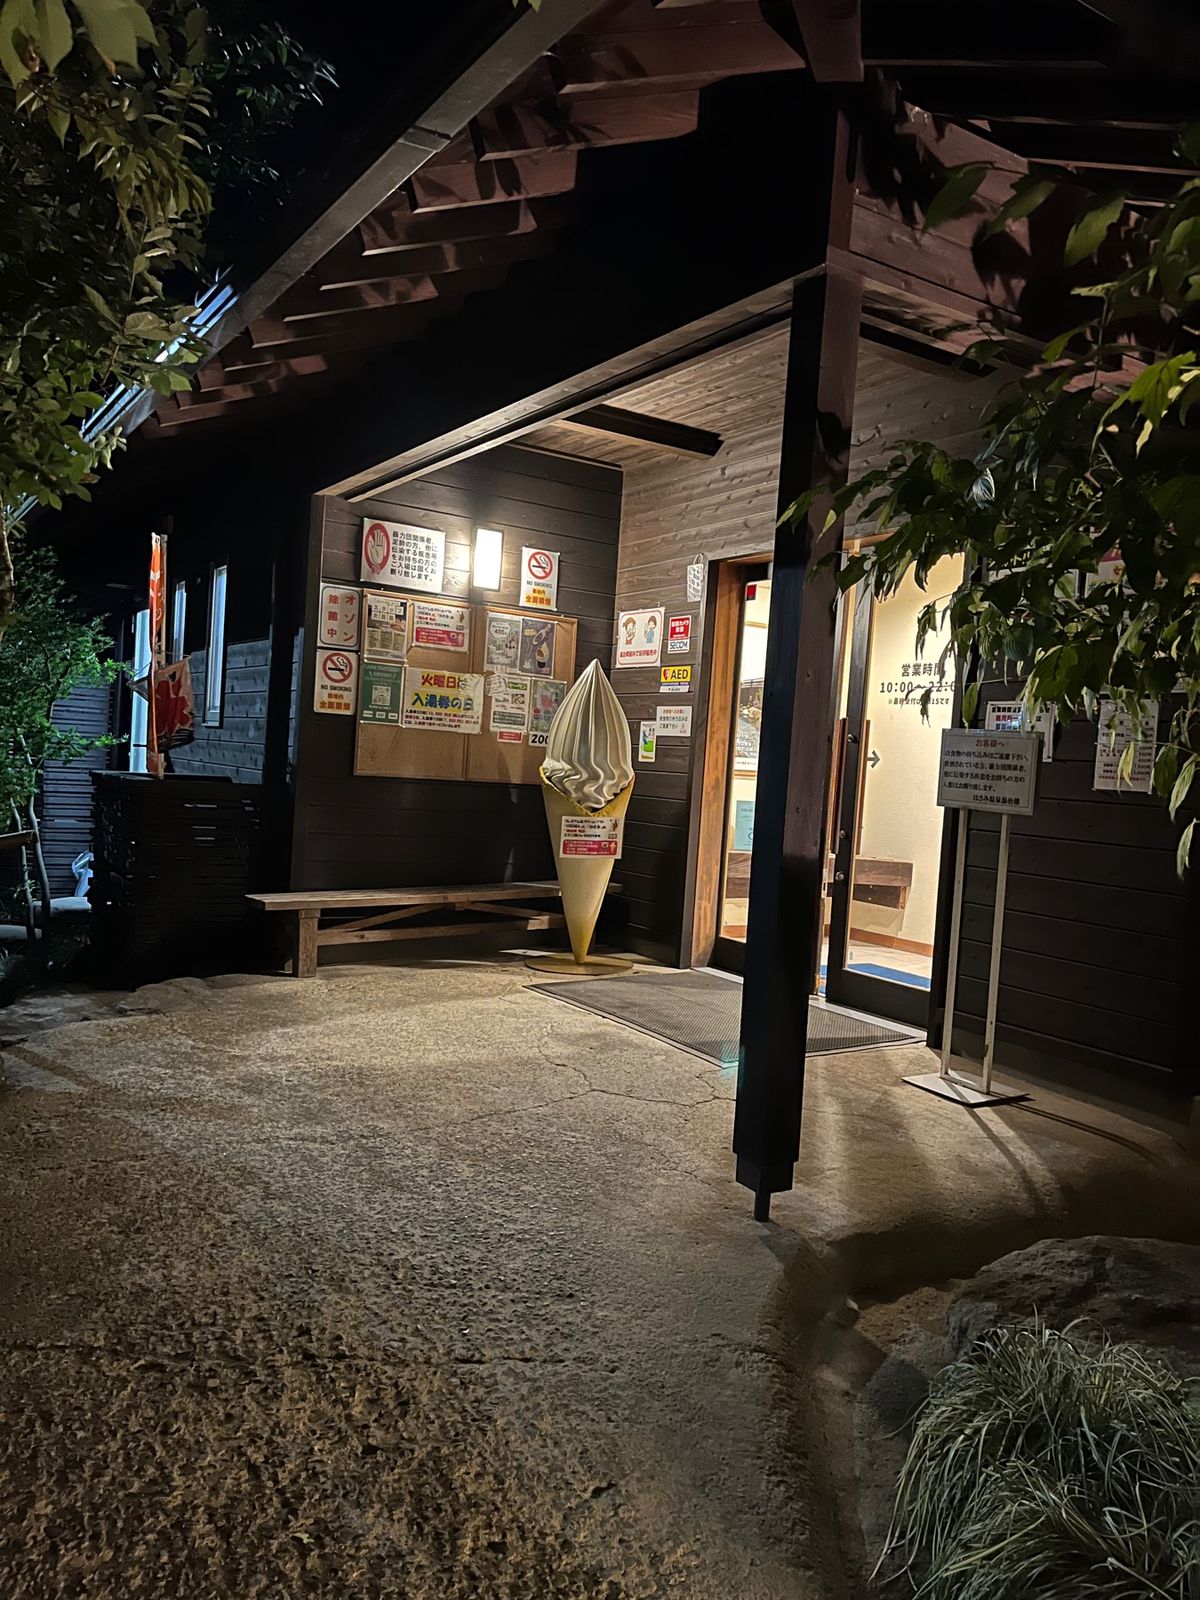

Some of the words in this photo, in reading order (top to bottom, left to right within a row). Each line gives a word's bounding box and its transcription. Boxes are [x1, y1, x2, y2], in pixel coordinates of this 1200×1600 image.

[327, 594, 340, 638] 除菌中
[669, 641, 688, 650] SECOM
[670, 669, 689, 680] AED
[901, 663, 944, 677] 営業時間
[329, 684, 352, 693] SMOKING
[319, 700, 351, 711] 全面禁煙
[975, 738, 1005, 748] お客様へ
